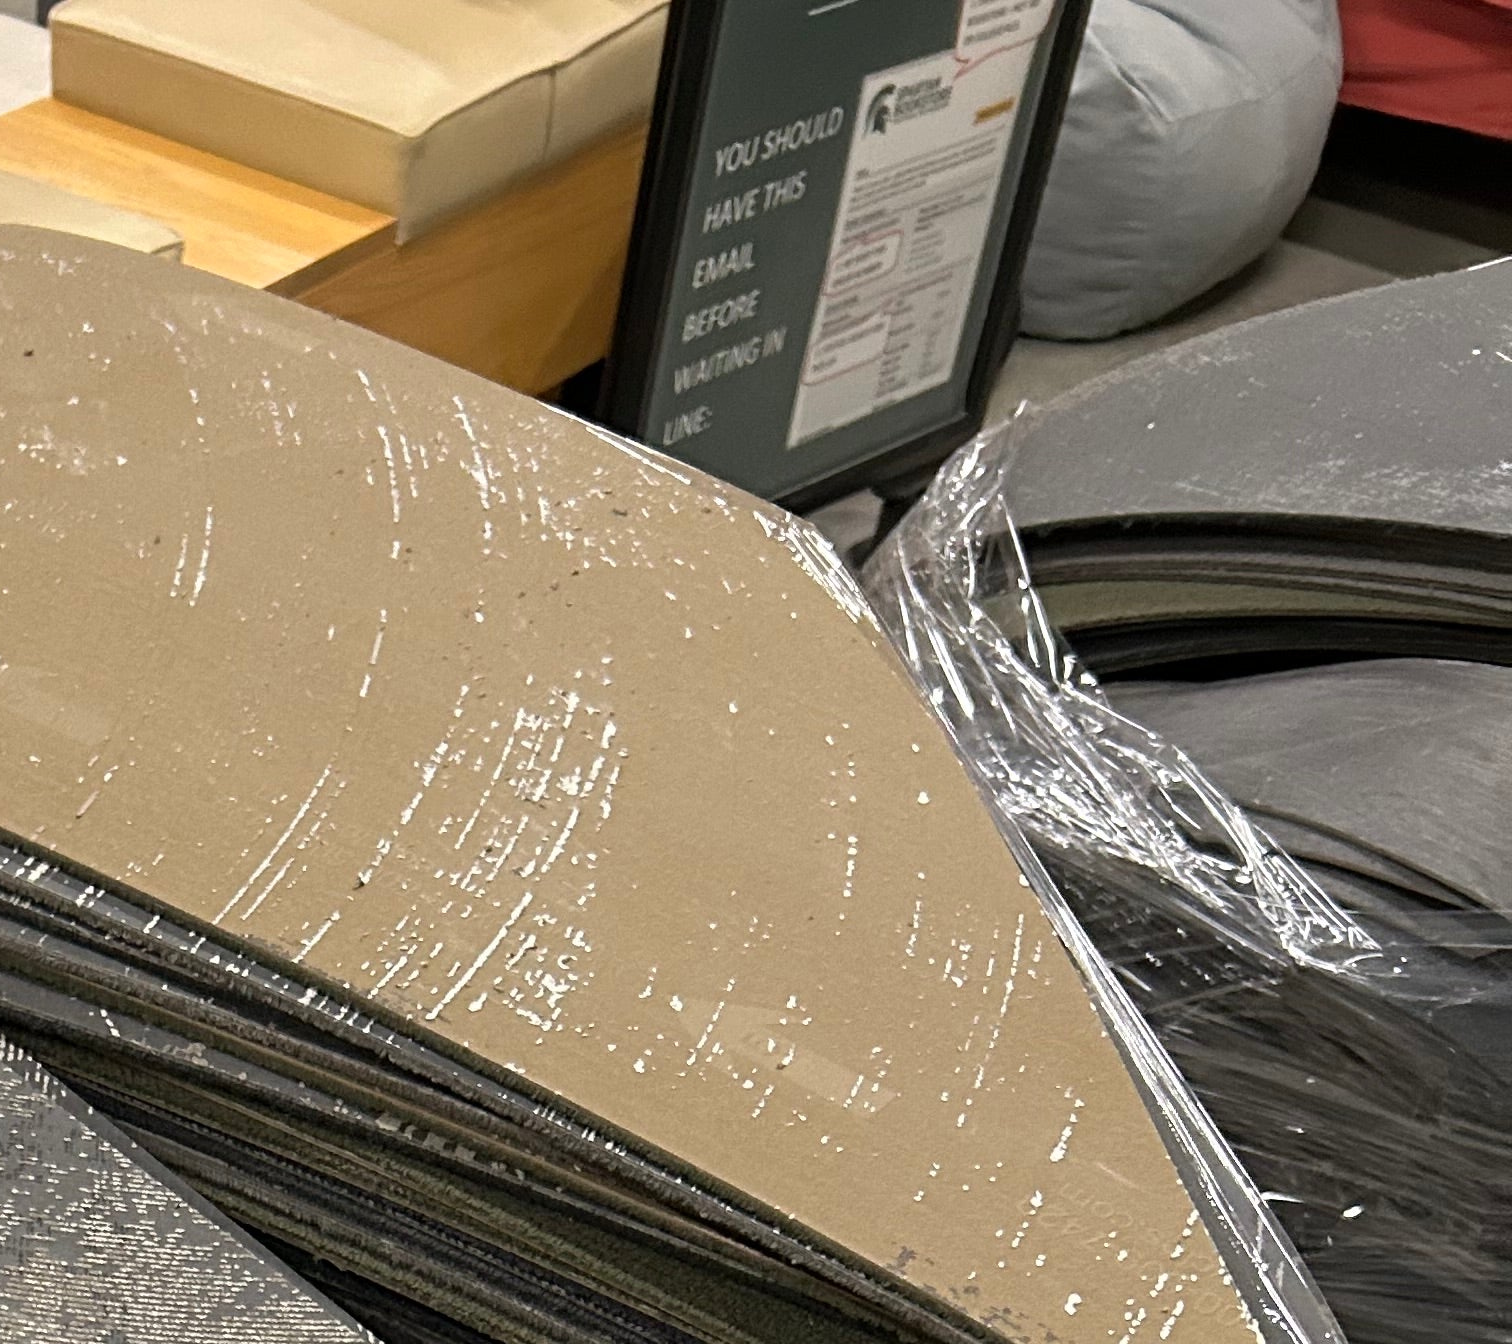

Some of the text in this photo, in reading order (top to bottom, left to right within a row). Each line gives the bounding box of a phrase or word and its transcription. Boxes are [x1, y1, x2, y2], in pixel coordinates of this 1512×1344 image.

[715, 106, 844, 177] YOU SHOULD
[702, 186, 761, 233] HAVE
[762, 169, 808, 212] THIS
[692, 242, 756, 289] EMAIL
[682, 289, 761, 344] BEFORE
[674, 336, 763, 395] WAITING
[762, 326, 787, 358] IN
